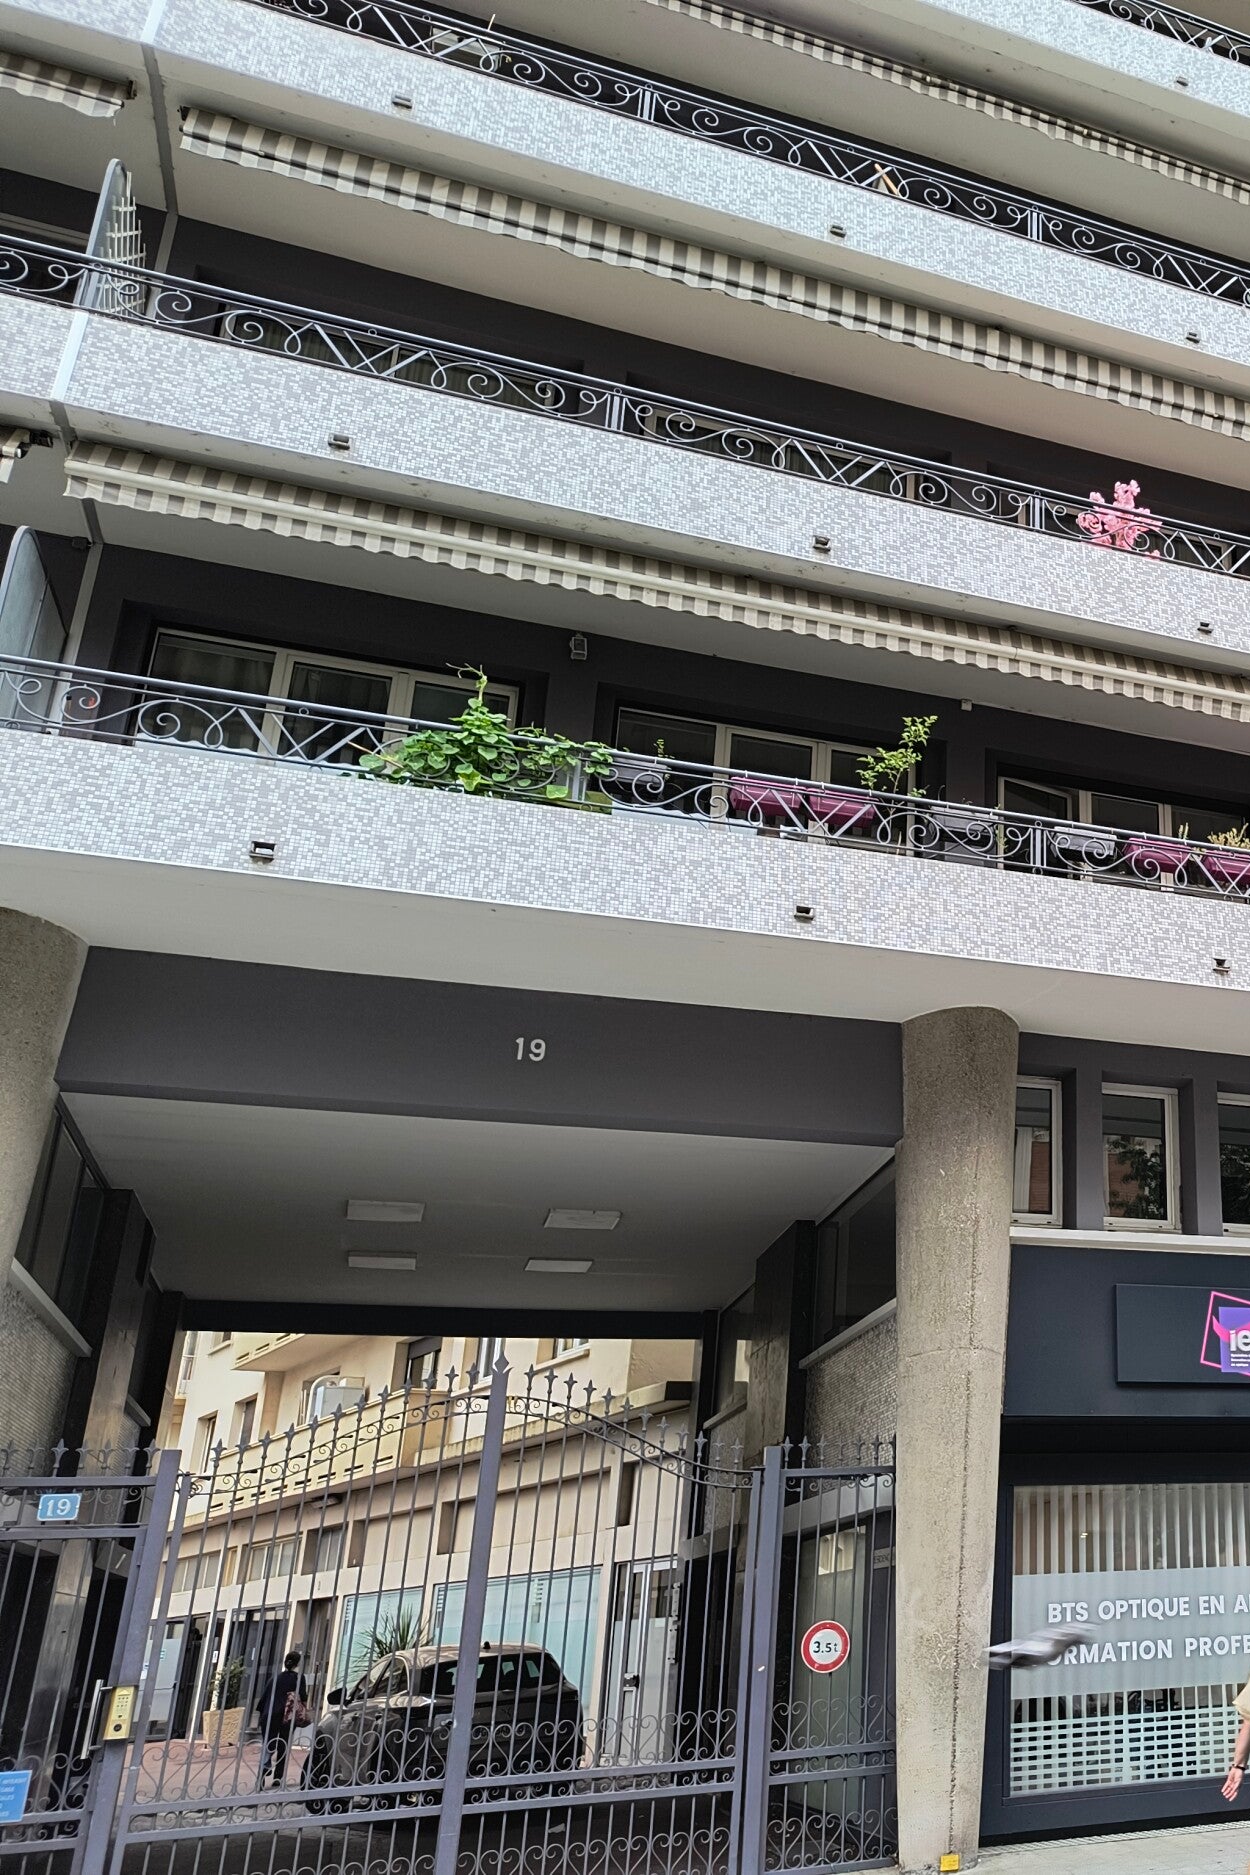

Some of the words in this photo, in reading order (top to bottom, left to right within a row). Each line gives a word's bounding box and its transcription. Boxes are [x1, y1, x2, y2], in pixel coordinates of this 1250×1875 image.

[515, 1037, 546, 1062] 19
[46, 1498, 72, 1517] 19
[1047, 1601, 1089, 1624] BTS
[1098, 1596, 1190, 1621] OPTIQUE
[1198, 1594, 1225, 1615] EN
[1046, 1638, 1173, 1667] RMATION
